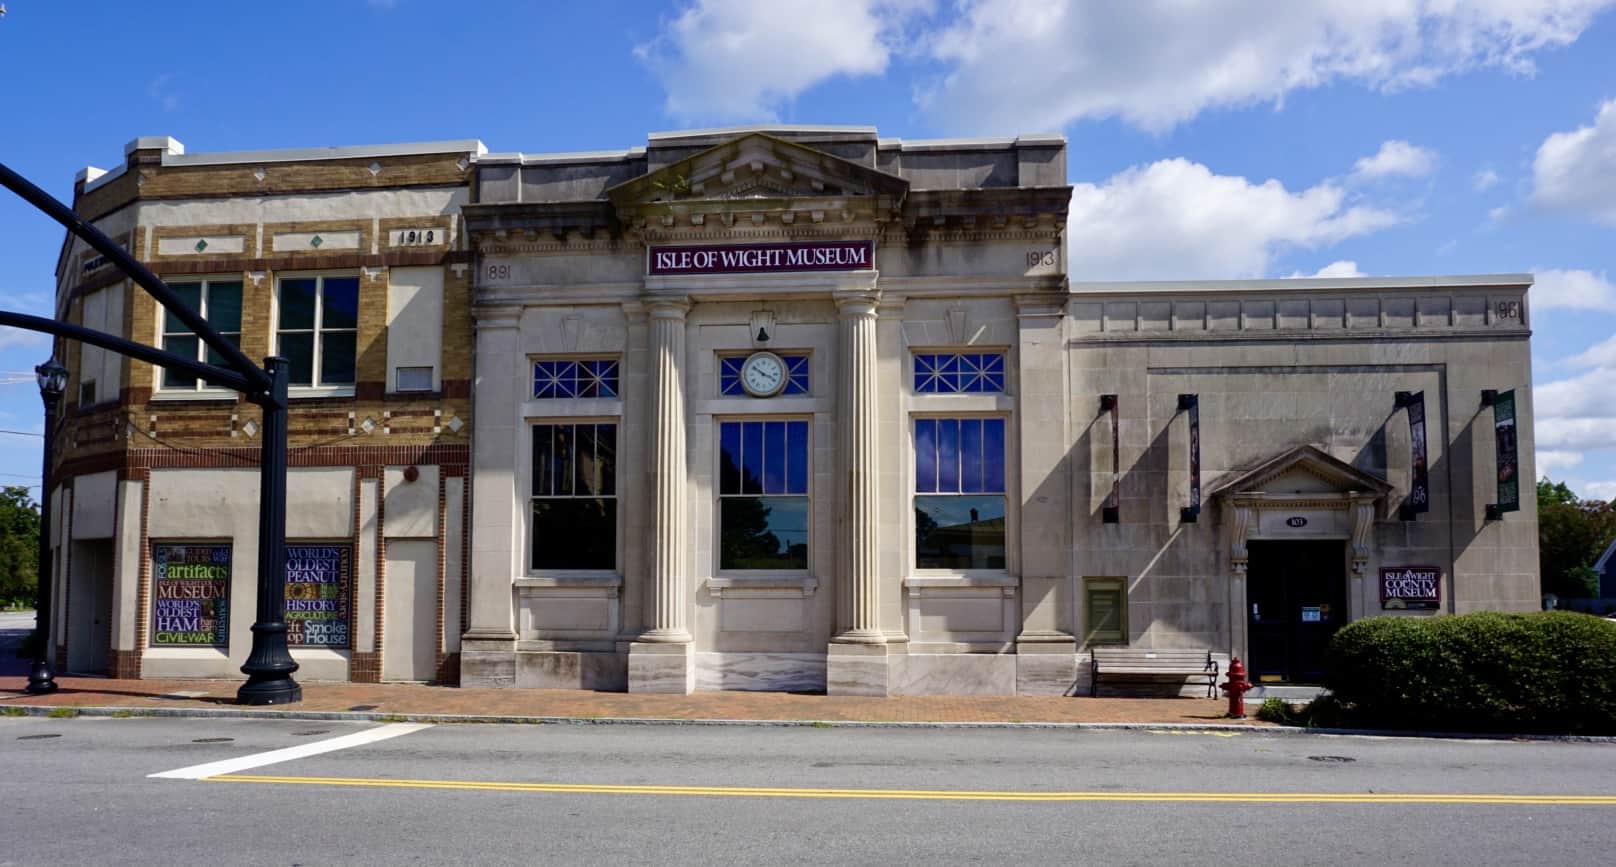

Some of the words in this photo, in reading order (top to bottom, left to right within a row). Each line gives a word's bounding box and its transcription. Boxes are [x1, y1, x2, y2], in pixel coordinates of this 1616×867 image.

[401, 231, 433, 243] 1913
[657, 252, 692, 269] ISLE
[693, 251, 717, 268] OF
[719, 249, 784, 267] WIGHT
[785, 247, 866, 265] MUSEUM
[1026, 251, 1054, 266] 1913
[485, 265, 511, 280] 1891
[1494, 302, 1521, 319] 1961
[287, 548, 339, 558] WORLD'S
[287, 559, 337, 570] OLDEST
[167, 564, 227, 579] artifacts
[287, 571, 338, 582] PEANUT
[1385, 572, 1402, 580] ISLE
[1409, 572, 1435, 580] WIGHT
[1385, 580, 1435, 588] COUNTY
[159, 586, 224, 599] MUSEUM
[1385, 588, 1436, 597] MUSEUM
[157, 599, 200, 608] WORLD'S
[286, 600, 337, 610] HISTORY
[157, 608, 198, 617] OLDEST
[158, 617, 199, 631] HAM
[304, 620, 346, 634] Smoke
[305, 631, 346, 644] House
